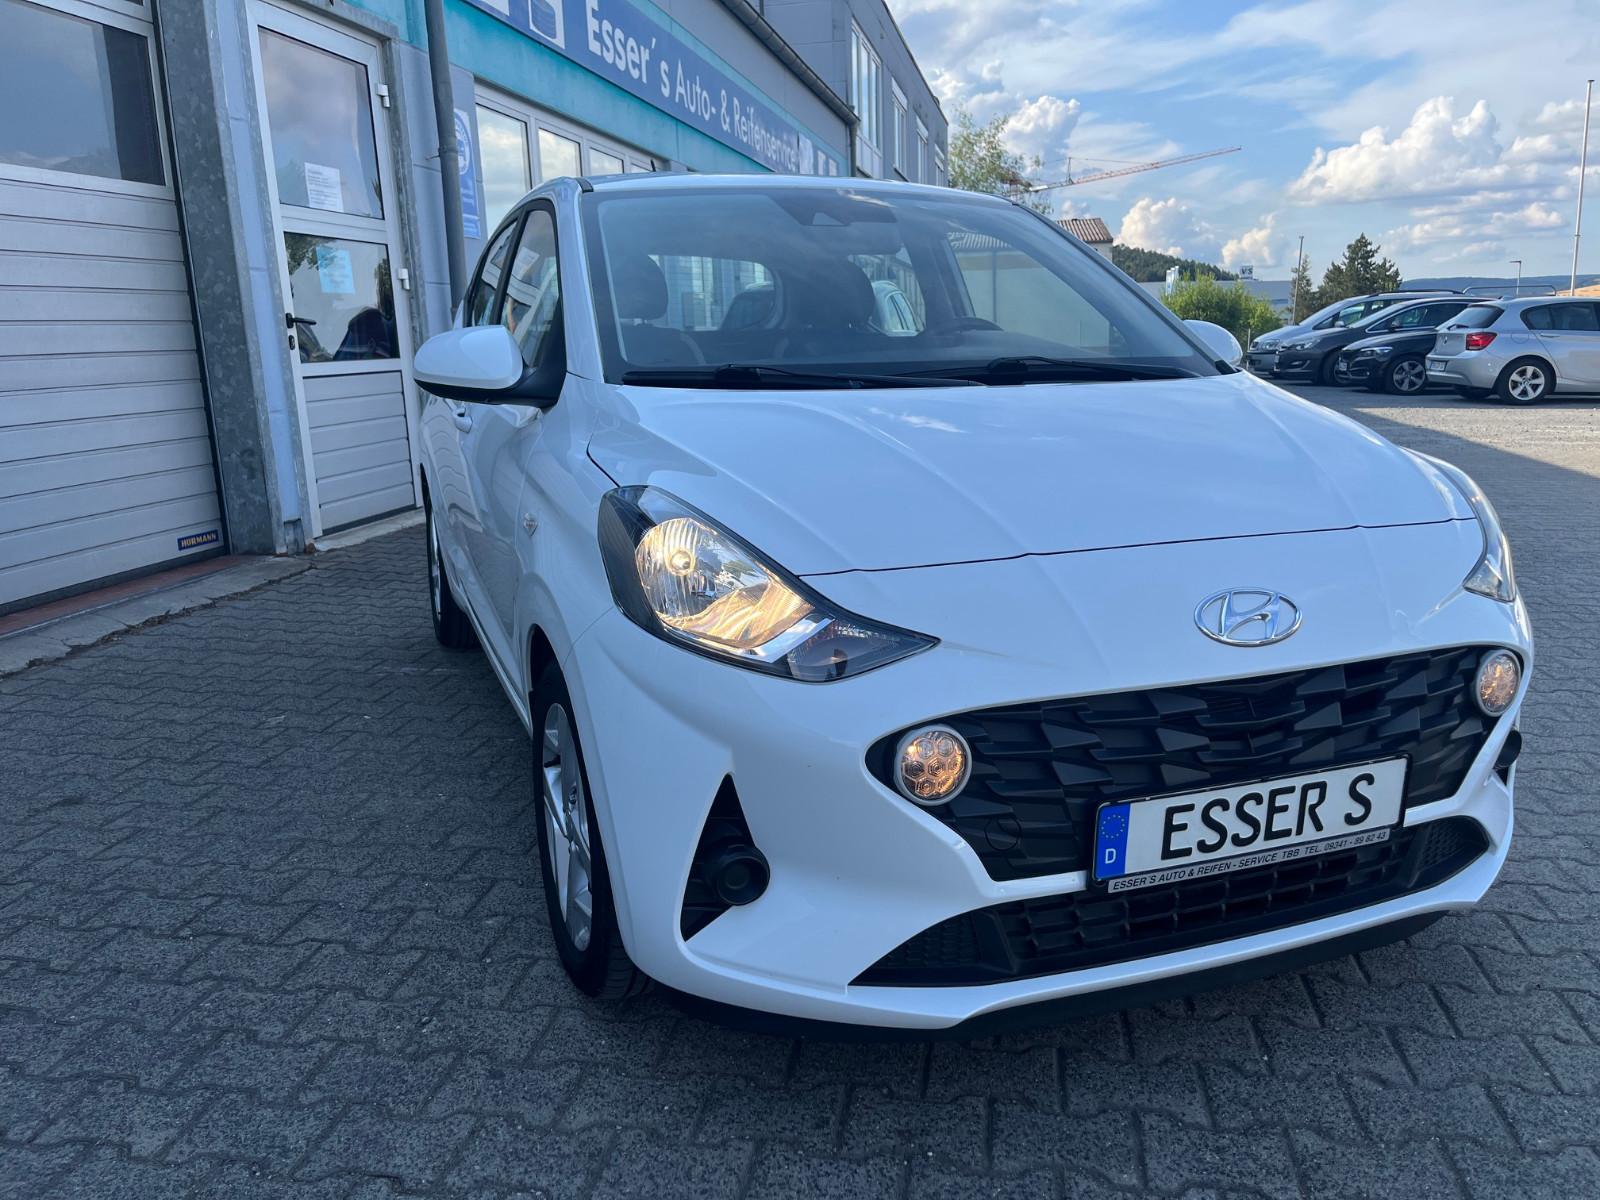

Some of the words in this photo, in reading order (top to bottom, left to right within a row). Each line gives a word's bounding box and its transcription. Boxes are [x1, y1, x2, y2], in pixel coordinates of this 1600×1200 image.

[675, 58, 717, 121] Auto-
[720, 89, 732, 134] &
[733, 97, 797, 173] Reifenservice
[1161, 781, 1327, 861] ESSER
[1345, 773, 1375, 826] S
[1105, 848, 1116, 864] D
[1159, 869, 1186, 883] AUTO
[1187, 868, 1194, 877] &
[1197, 862, 1232, 876] REIFEN
[1238, 854, 1278, 869] SERVICE
[1282, 848, 1300, 860] TBB
